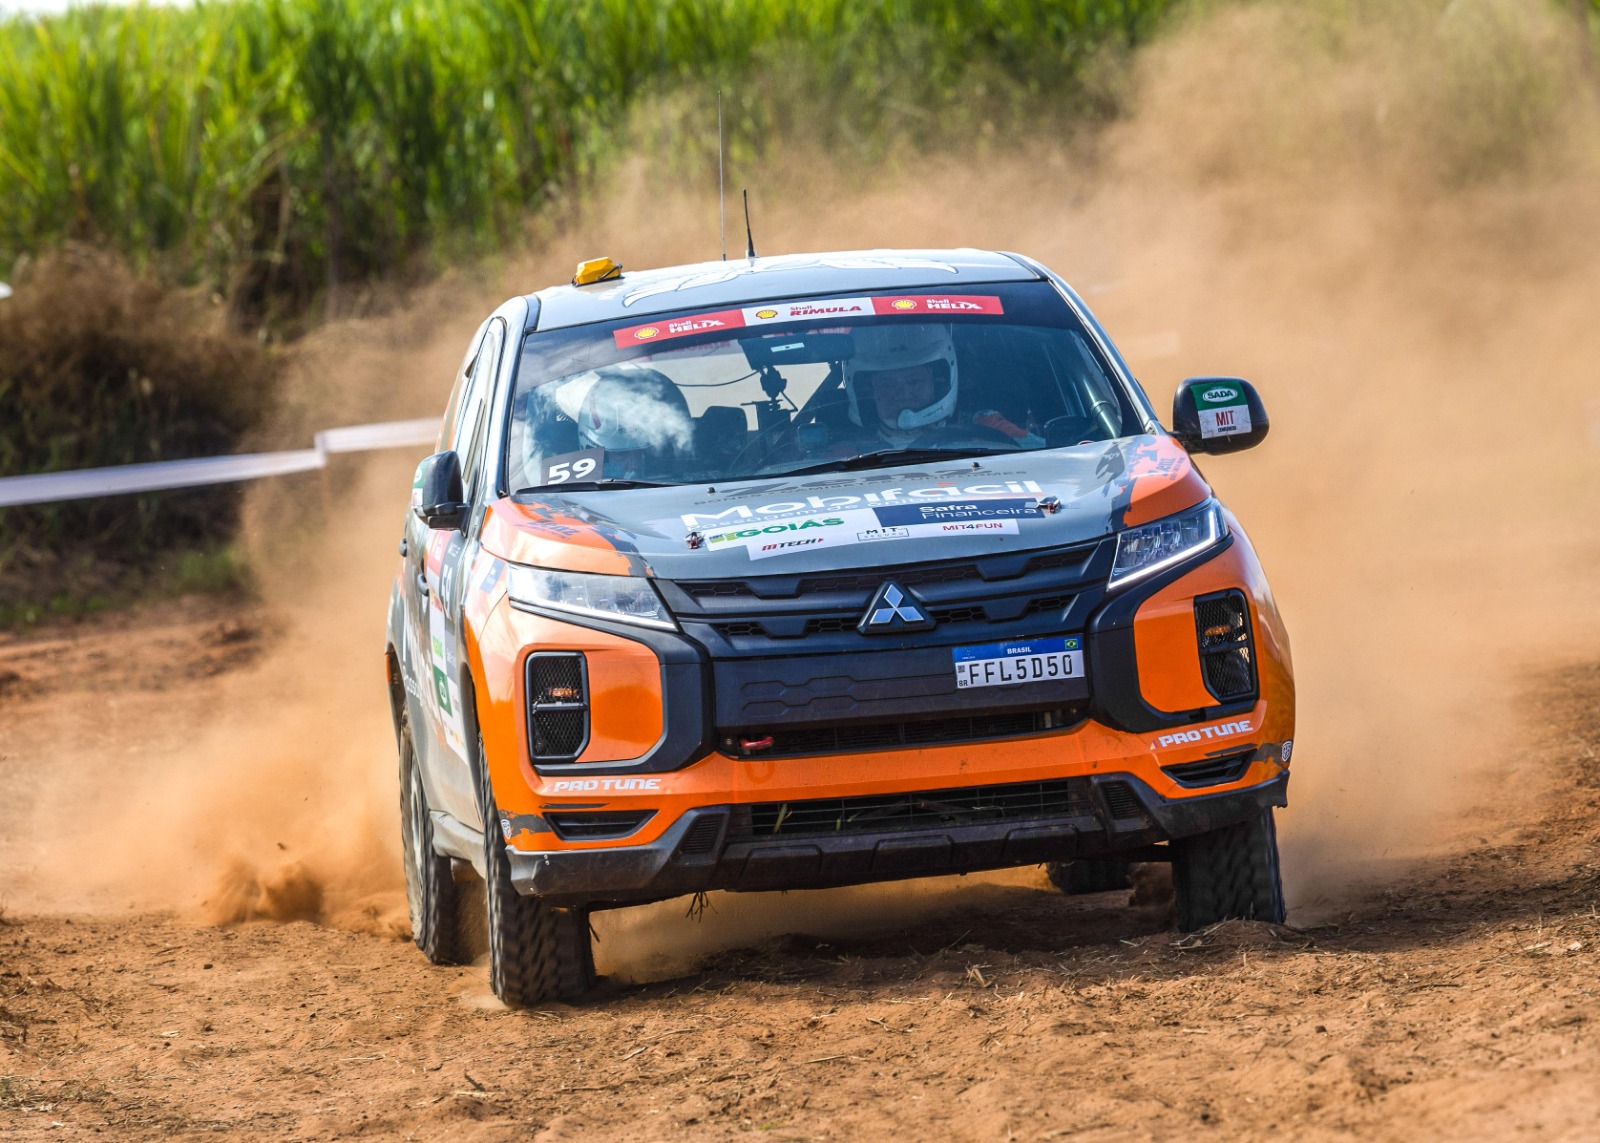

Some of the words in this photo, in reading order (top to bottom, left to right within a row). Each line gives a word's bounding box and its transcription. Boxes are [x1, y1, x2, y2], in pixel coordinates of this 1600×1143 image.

[789, 305, 863, 316] RIMULA
[926, 302, 983, 310] HELIX
[668, 320, 692, 328] Shell
[669, 319, 726, 334] HELIX
[1207, 390, 1234, 399] SADA
[1215, 410, 1234, 427] MIT
[546, 457, 597, 485] 59
[918, 503, 978, 514] Safra
[921, 507, 1039, 521] Financeira
[866, 527, 899, 535] MIT
[942, 522, 1004, 532] MIT4FUN
[1006, 645, 1032, 655] BRASIL
[968, 653, 1074, 685] FFL5D50
[958, 679, 969, 687] BR
[1158, 729, 1202, 748] PRO
[1200, 719, 1254, 739] TUNE
[553, 778, 598, 792] PRO
[597, 777, 662, 791] TUNE
